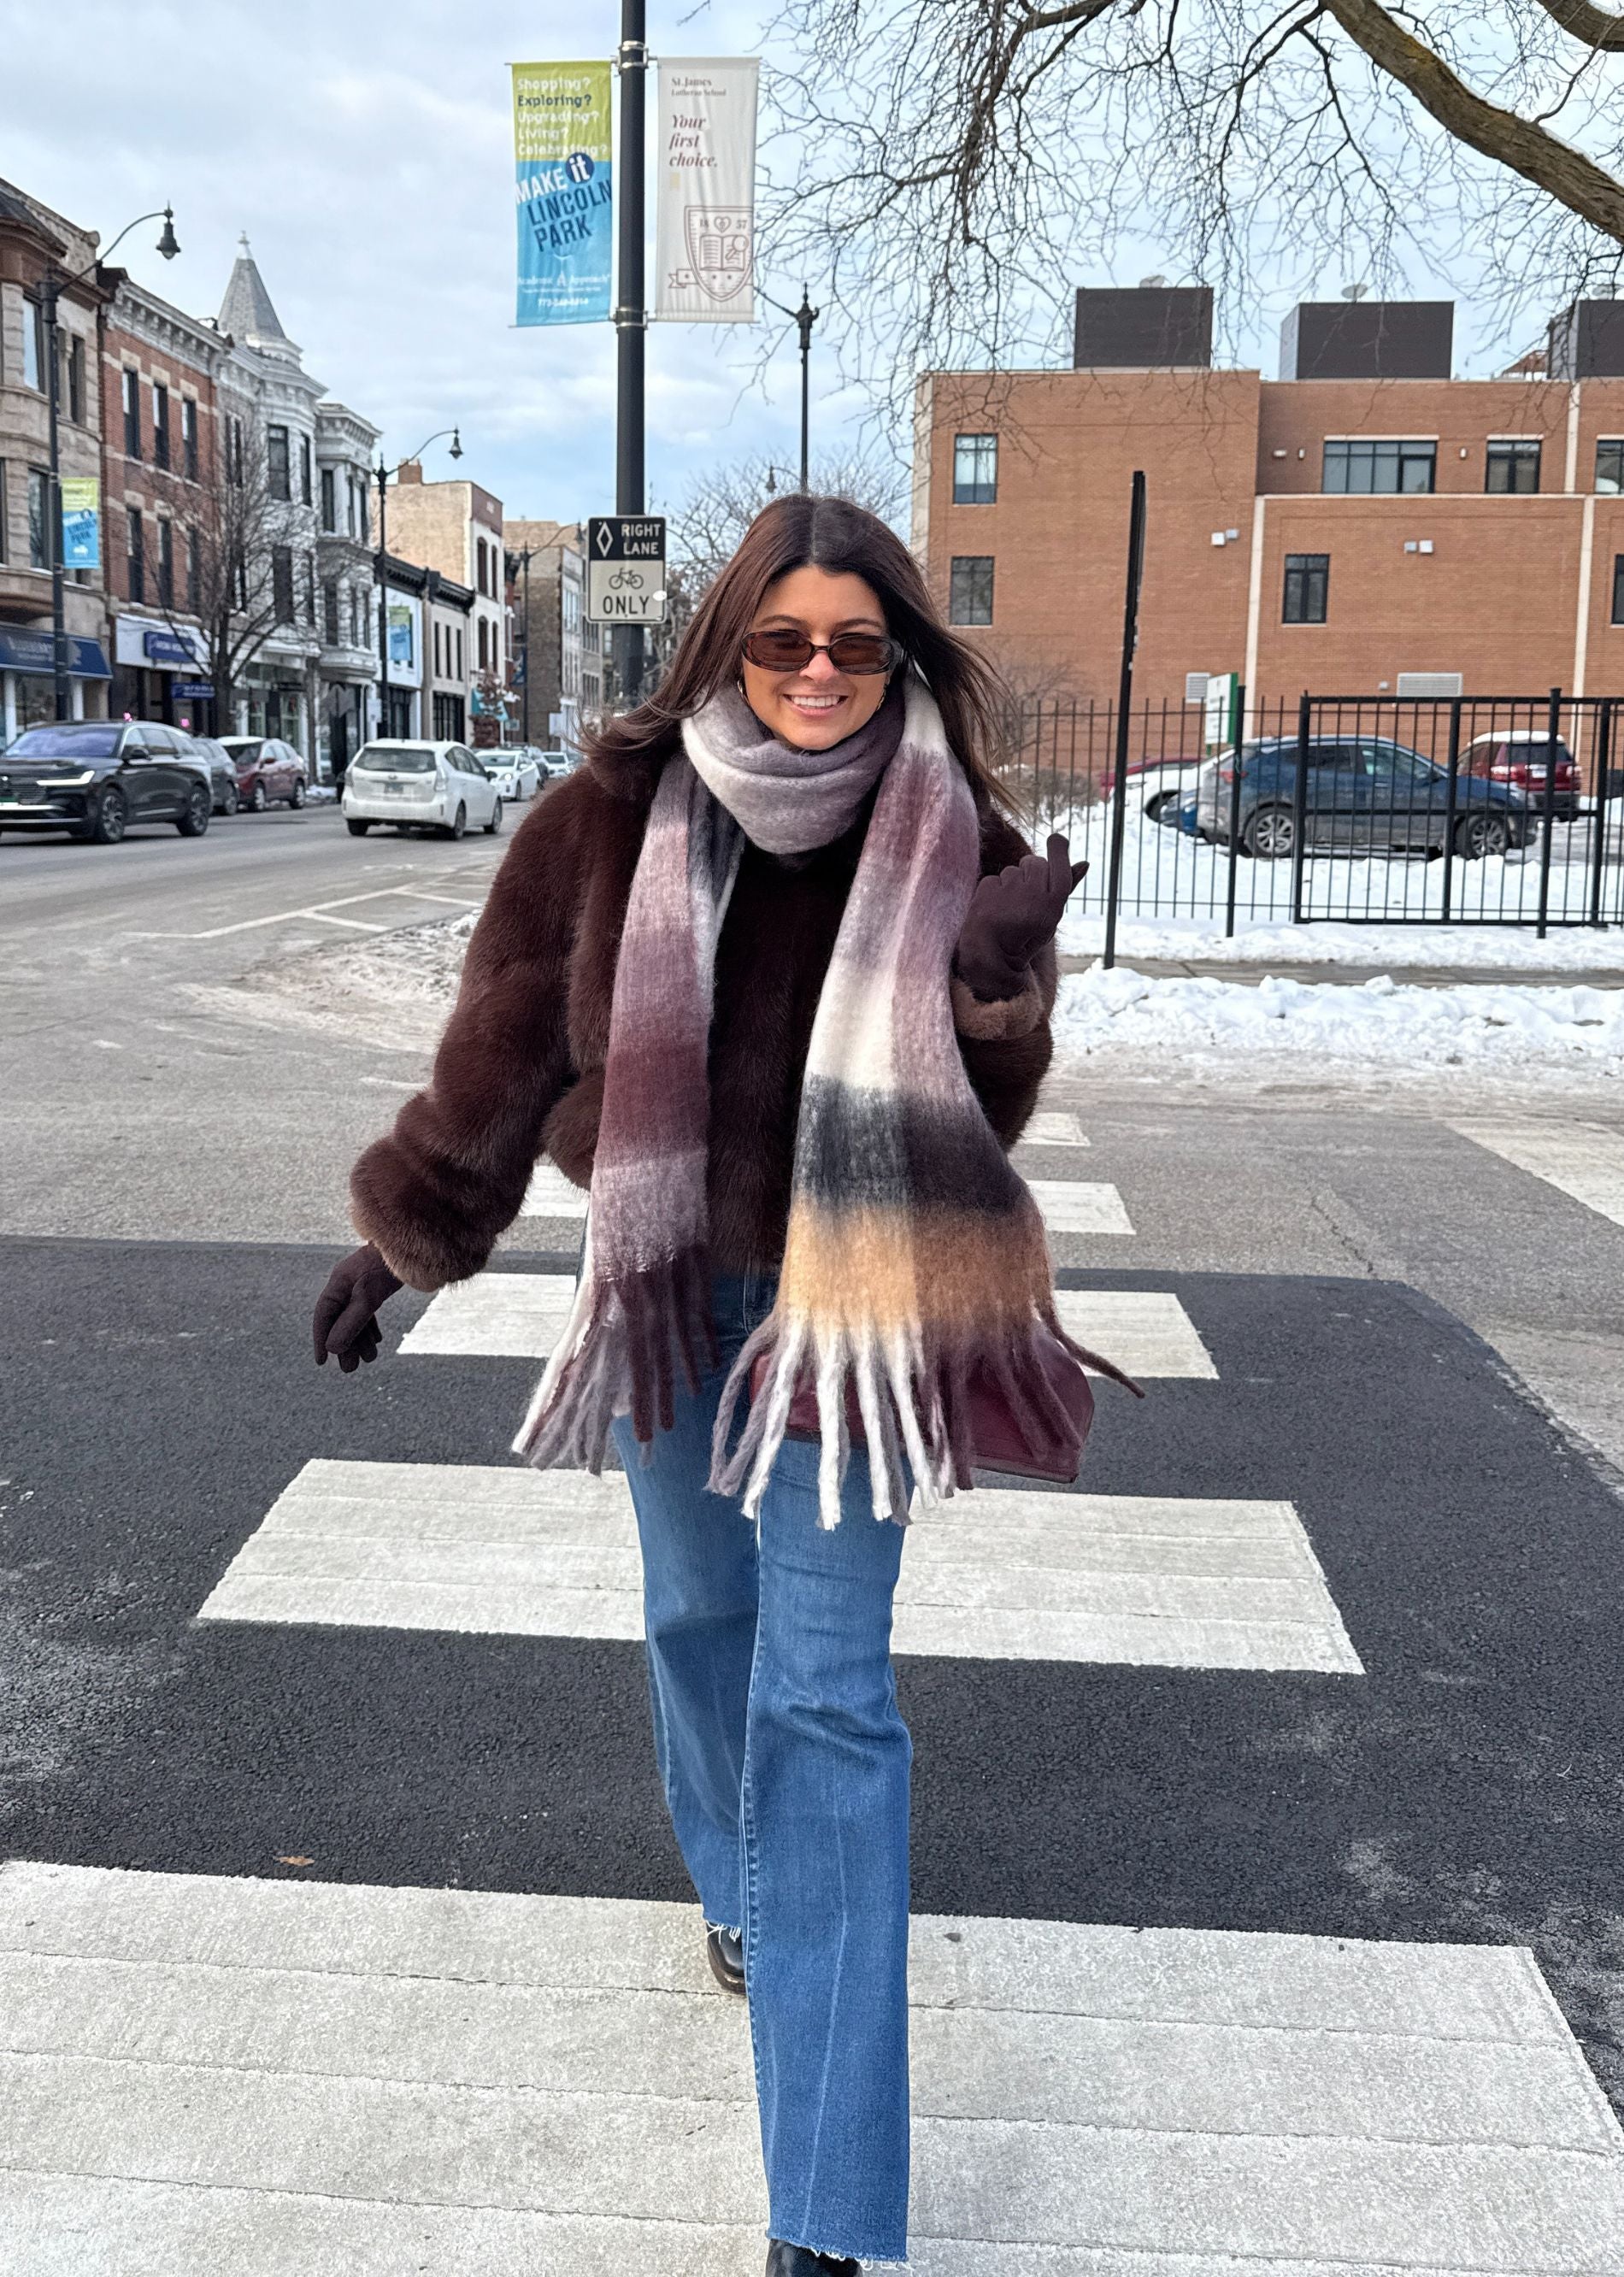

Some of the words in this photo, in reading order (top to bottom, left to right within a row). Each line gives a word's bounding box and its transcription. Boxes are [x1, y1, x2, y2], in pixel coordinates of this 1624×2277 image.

[518, 77, 591, 91] Shopping?
[685, 76, 712, 87] James
[703, 88, 727, 97] School
[518, 94, 592, 108] Exploring?
[518, 110, 599, 126] Upgrading?
[672, 115, 707, 129] Your
[519, 127, 569, 141] Living?
[668, 132, 699, 150] first
[519, 143, 608, 157] Celebrating?
[668, 152, 718, 168] choice.
[515, 167, 568, 205] MAKE
[569, 155, 590, 183] it
[527, 179, 612, 226] LINCOLN
[534, 215, 592, 253] PARK
[621, 524, 661, 537] RIGHT
[623, 542, 659, 555] LANE
[603, 596, 650, 615] ONLY
